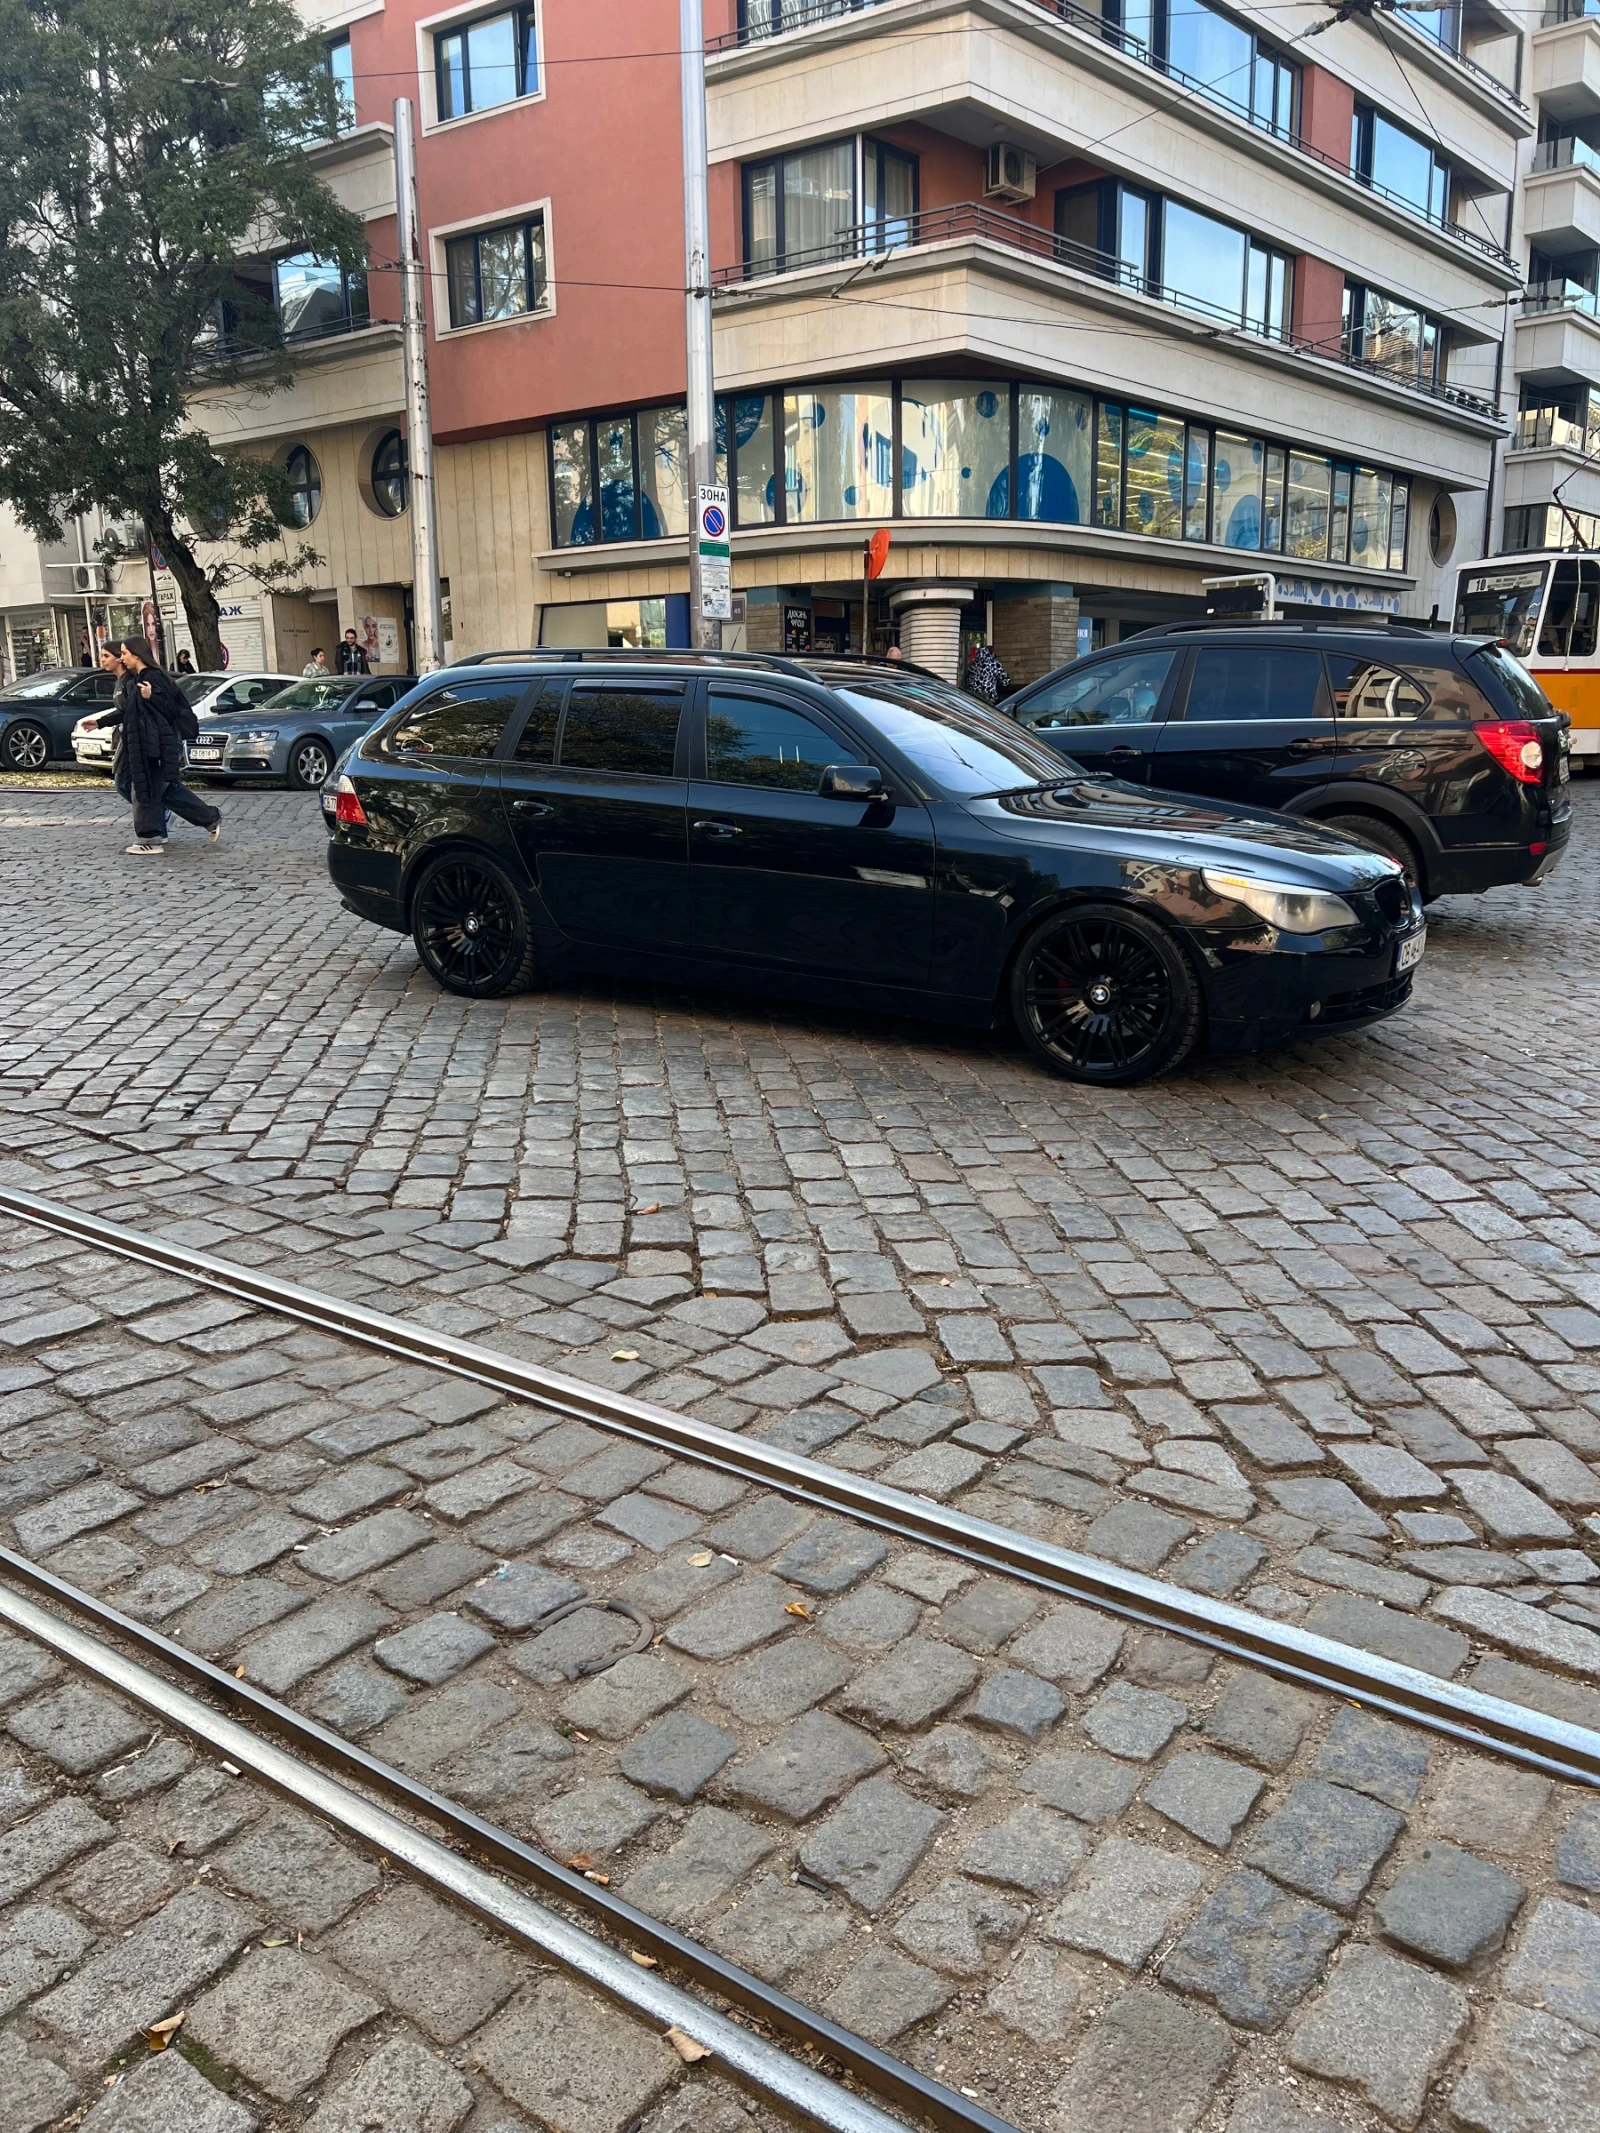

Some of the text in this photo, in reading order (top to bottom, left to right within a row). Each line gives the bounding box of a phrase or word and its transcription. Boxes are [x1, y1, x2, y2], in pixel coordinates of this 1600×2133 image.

[700, 488, 726, 502] ЗОНА
[1476, 579, 1487, 592] 10
[219, 606, 243, 616] АЖ
[814, 640, 835, 651] affitaly
